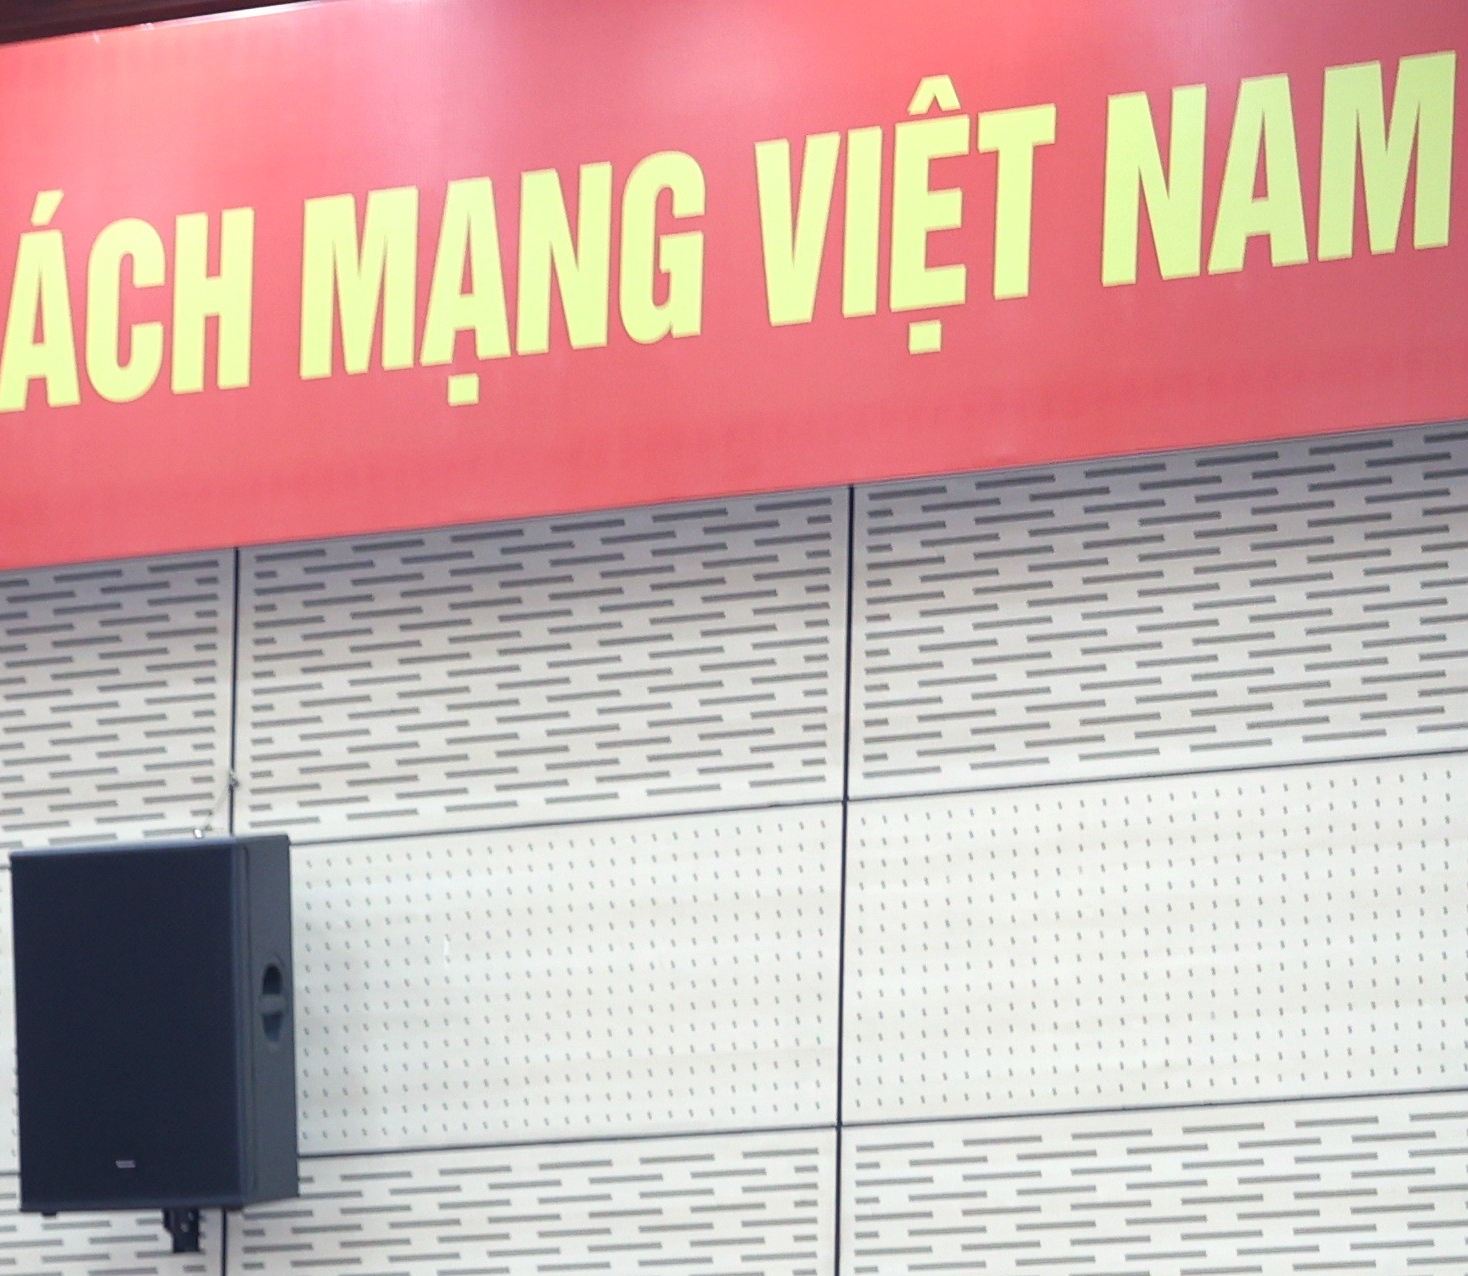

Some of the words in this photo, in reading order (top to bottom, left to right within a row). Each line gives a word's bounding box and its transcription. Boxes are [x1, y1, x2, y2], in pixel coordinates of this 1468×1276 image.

[300, 150, 706, 406] MẠNG
[755, 74, 1057, 354] VIỆT
[1103, 49, 1457, 287] NAM
